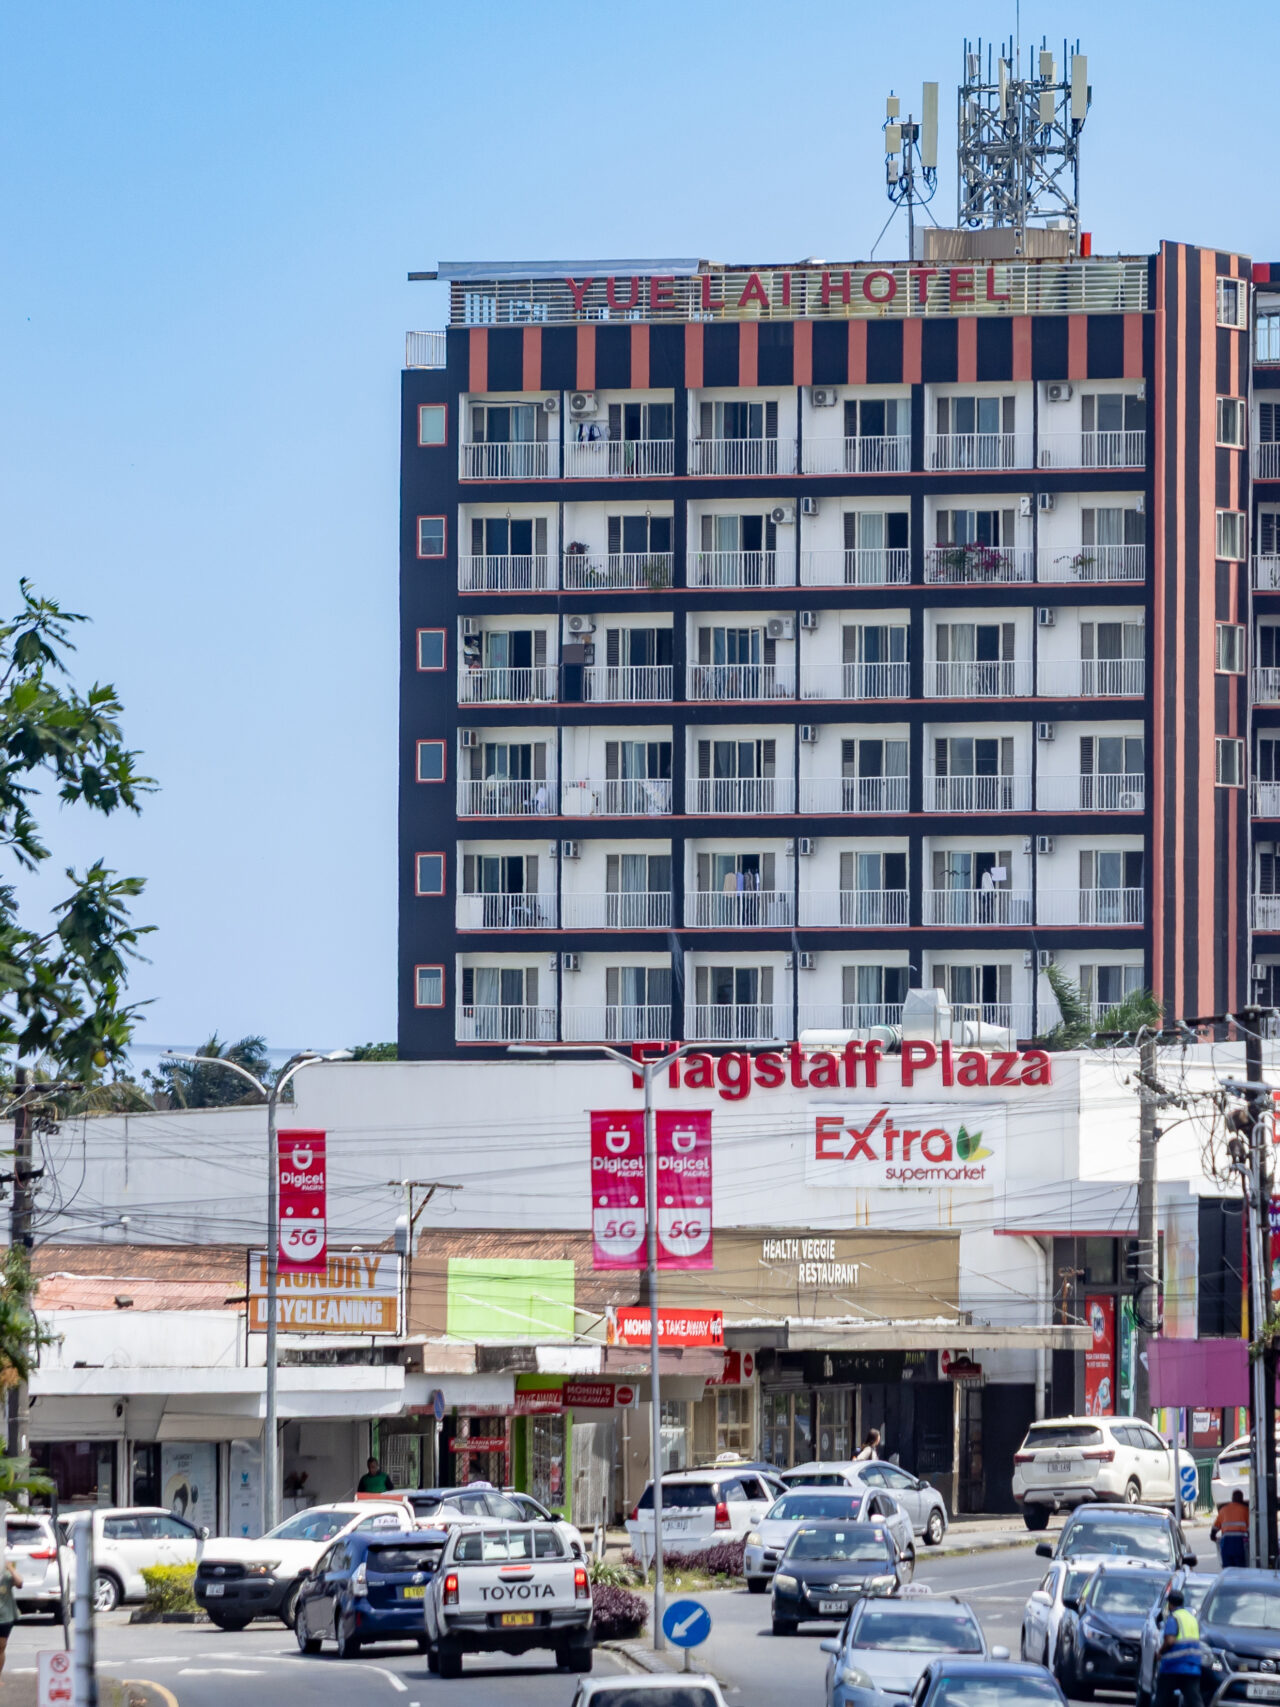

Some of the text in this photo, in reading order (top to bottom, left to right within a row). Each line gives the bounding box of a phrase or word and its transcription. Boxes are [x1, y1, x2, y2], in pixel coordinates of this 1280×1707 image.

[565, 267, 1011, 310] YUE LAI HOTEL
[632, 1038, 1052, 1101] Flagstaff Plaza
[592, 1156, 644, 1174] Digicel
[617, 1169, 644, 1178] PACIFIC
[658, 1156, 710, 1174] Digicel
[683, 1169, 710, 1178] PACIFIC
[885, 1165, 987, 1181] supermarket
[281, 1172, 324, 1188] Digicel
[288, 1228, 318, 1246] 5G
[604, 1220, 637, 1239] 5G
[668, 1220, 702, 1239] 5G
[763, 1239, 836, 1260] HEALTH VEGGIE
[799, 1263, 859, 1284] RESTAURANT
[624, 1319, 664, 1336] MOHINS
[665, 1319, 709, 1336] TAKEAWAY
[567, 1386, 611, 1395] MOHINI'S
[479, 1584, 555, 1601] TOYOTA
